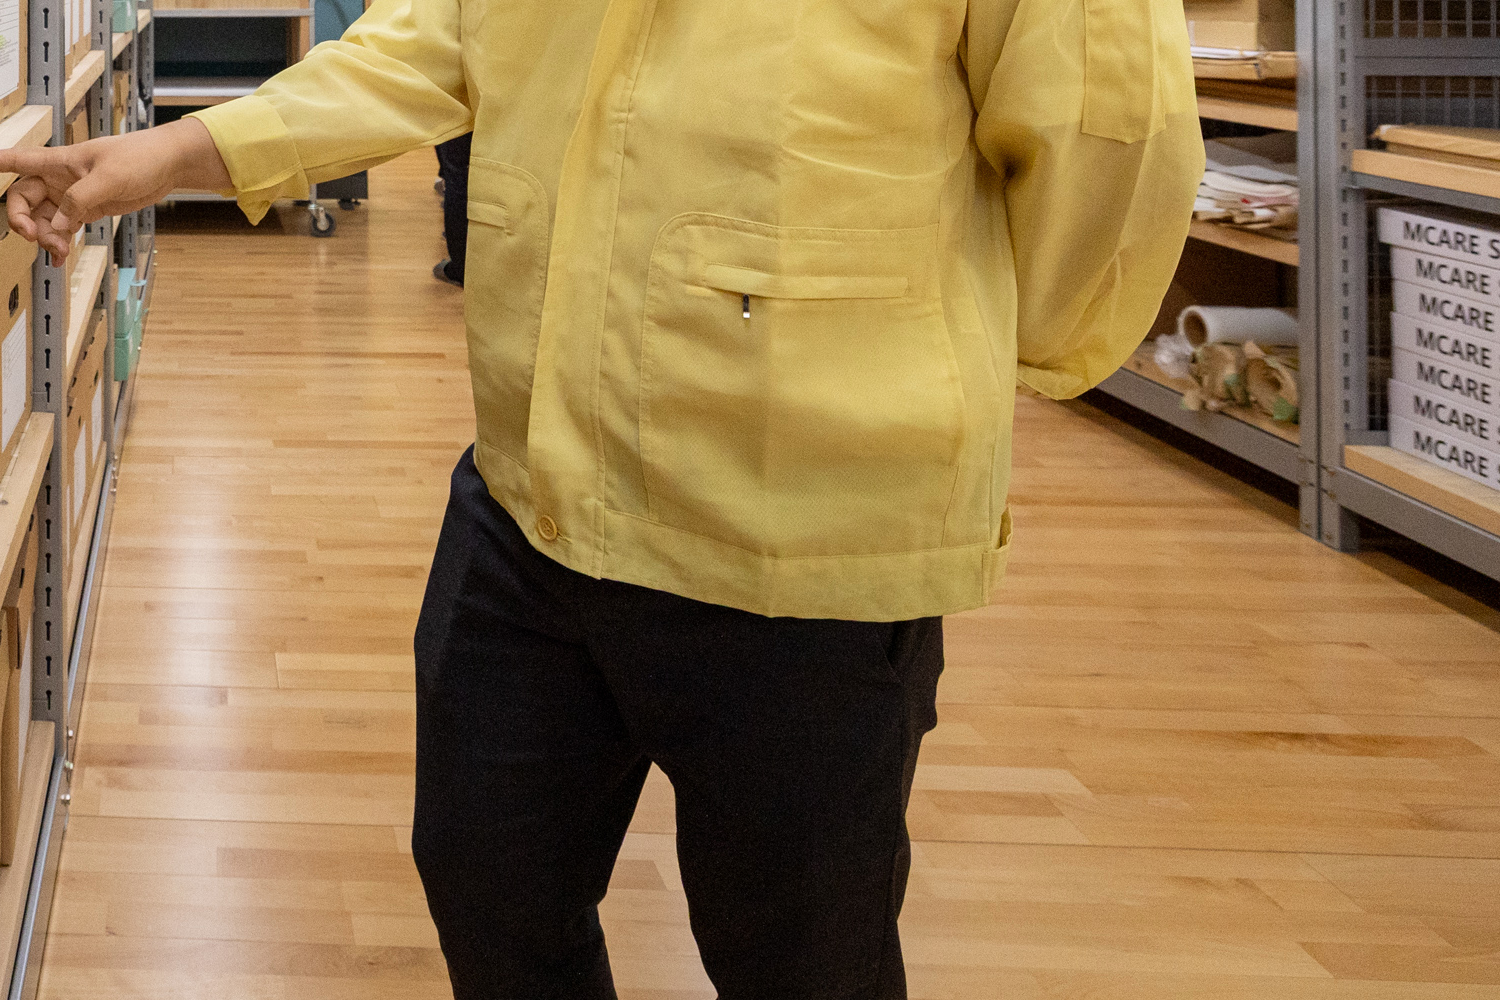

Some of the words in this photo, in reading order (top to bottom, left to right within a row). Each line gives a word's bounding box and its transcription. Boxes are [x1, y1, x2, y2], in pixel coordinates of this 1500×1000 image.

[1403, 221, 1479, 255] MCARE
[1416, 258, 1491, 295] MCARE
[1419, 293, 1495, 333] MCARE
[1416, 327, 1492, 369] MCARE
[1417, 361, 1492, 405] MCARE
[1414, 395, 1490, 440] MCARE
[1414, 430, 1489, 478] MCARE
